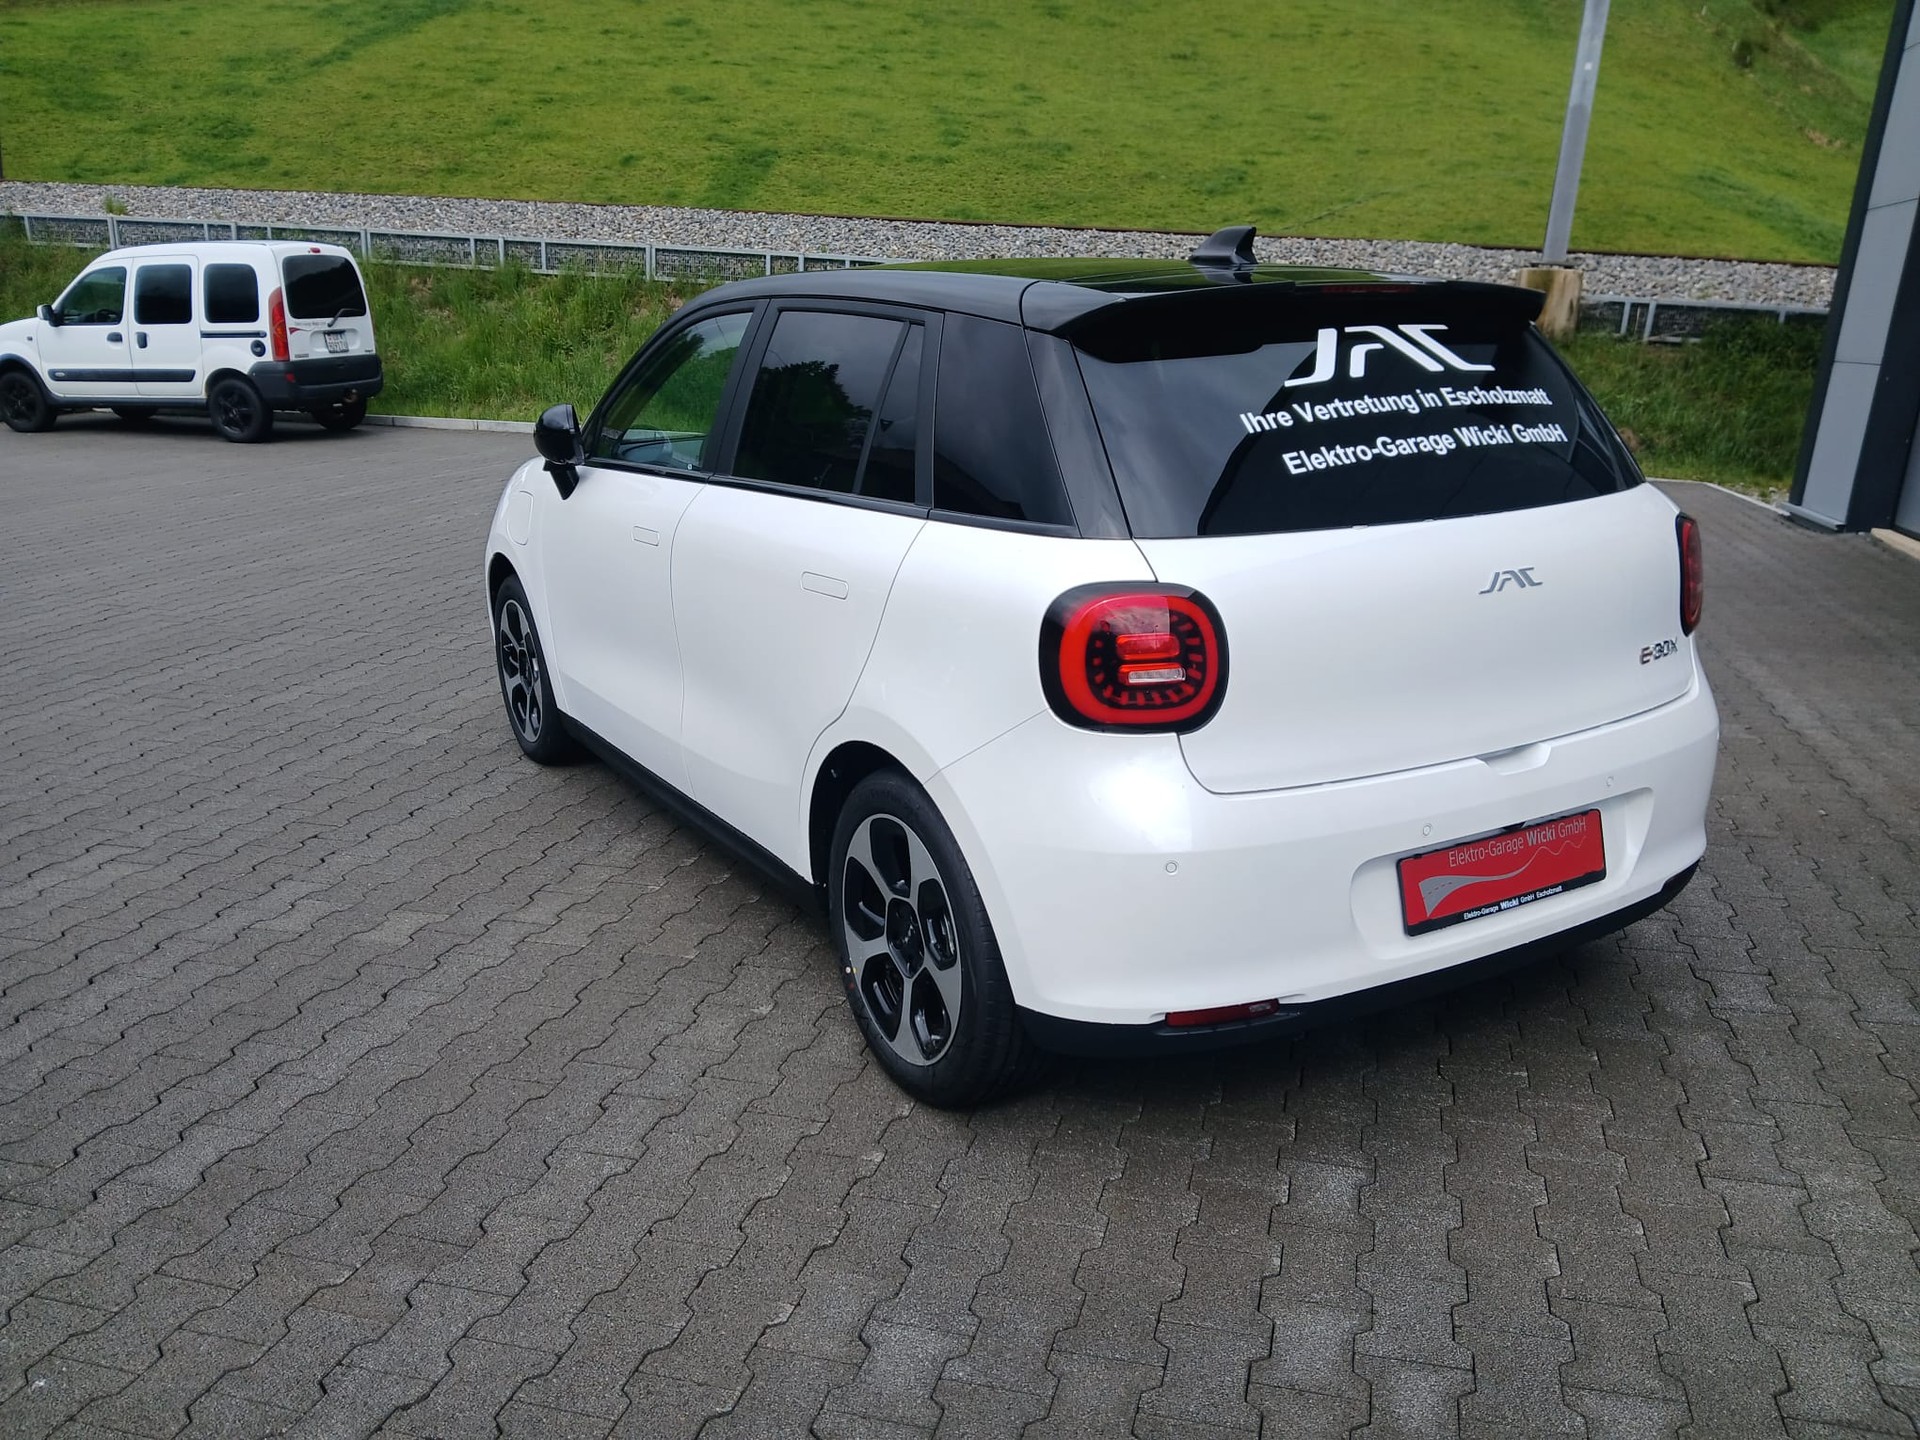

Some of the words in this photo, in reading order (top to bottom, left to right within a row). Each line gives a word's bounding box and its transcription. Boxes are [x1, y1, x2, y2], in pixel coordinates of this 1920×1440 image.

[1240, 410, 1294, 434] Ihre
[1293, 389, 1420, 425] Vertretung
[1417, 388, 1442, 408] in
[1439, 385, 1553, 406] Escholzmatt
[1282, 432, 1456, 475] Elektro-Garage
[1454, 424, 1513, 448] Wicki
[1513, 423, 1568, 443] GmbH
[1449, 837, 1524, 867] Elektro-Garage
[1526, 824, 1557, 846] Wicki
[1558, 817, 1587, 838] GmbH
[1500, 897, 1519, 910] Wicki
